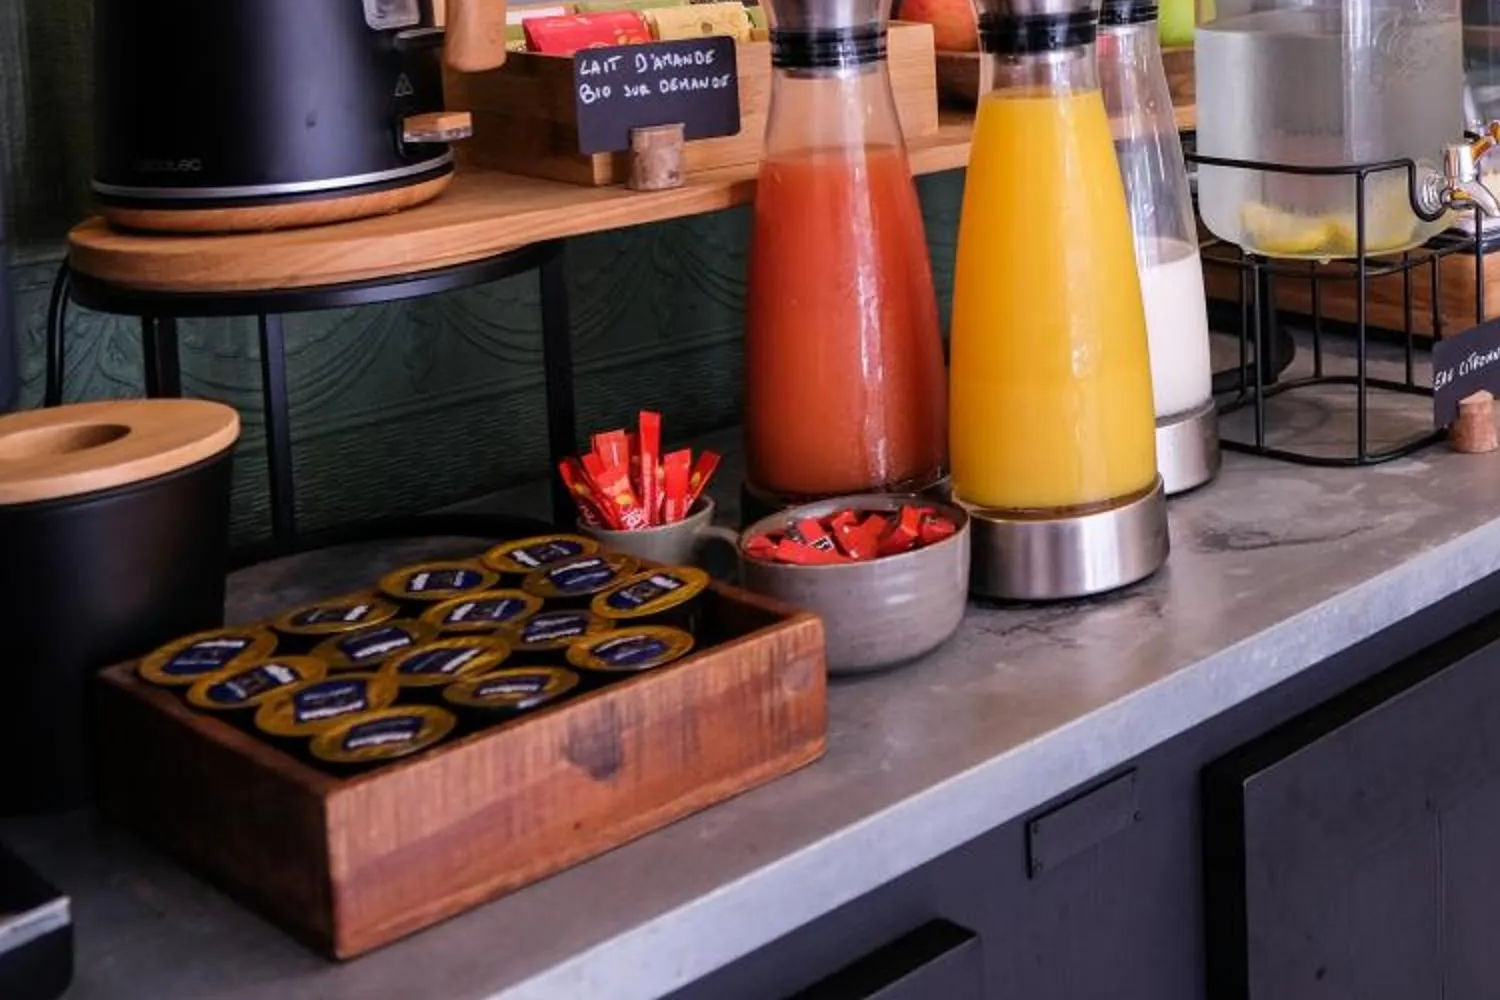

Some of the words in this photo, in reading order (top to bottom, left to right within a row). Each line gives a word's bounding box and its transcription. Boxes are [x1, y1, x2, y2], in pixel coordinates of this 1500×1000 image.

[579, 54, 623, 76] LAIT
[635, 49, 716, 73] D'AMANDE
[623, 83, 651, 98] SUR
[659, 74, 730, 94] DEMANDE
